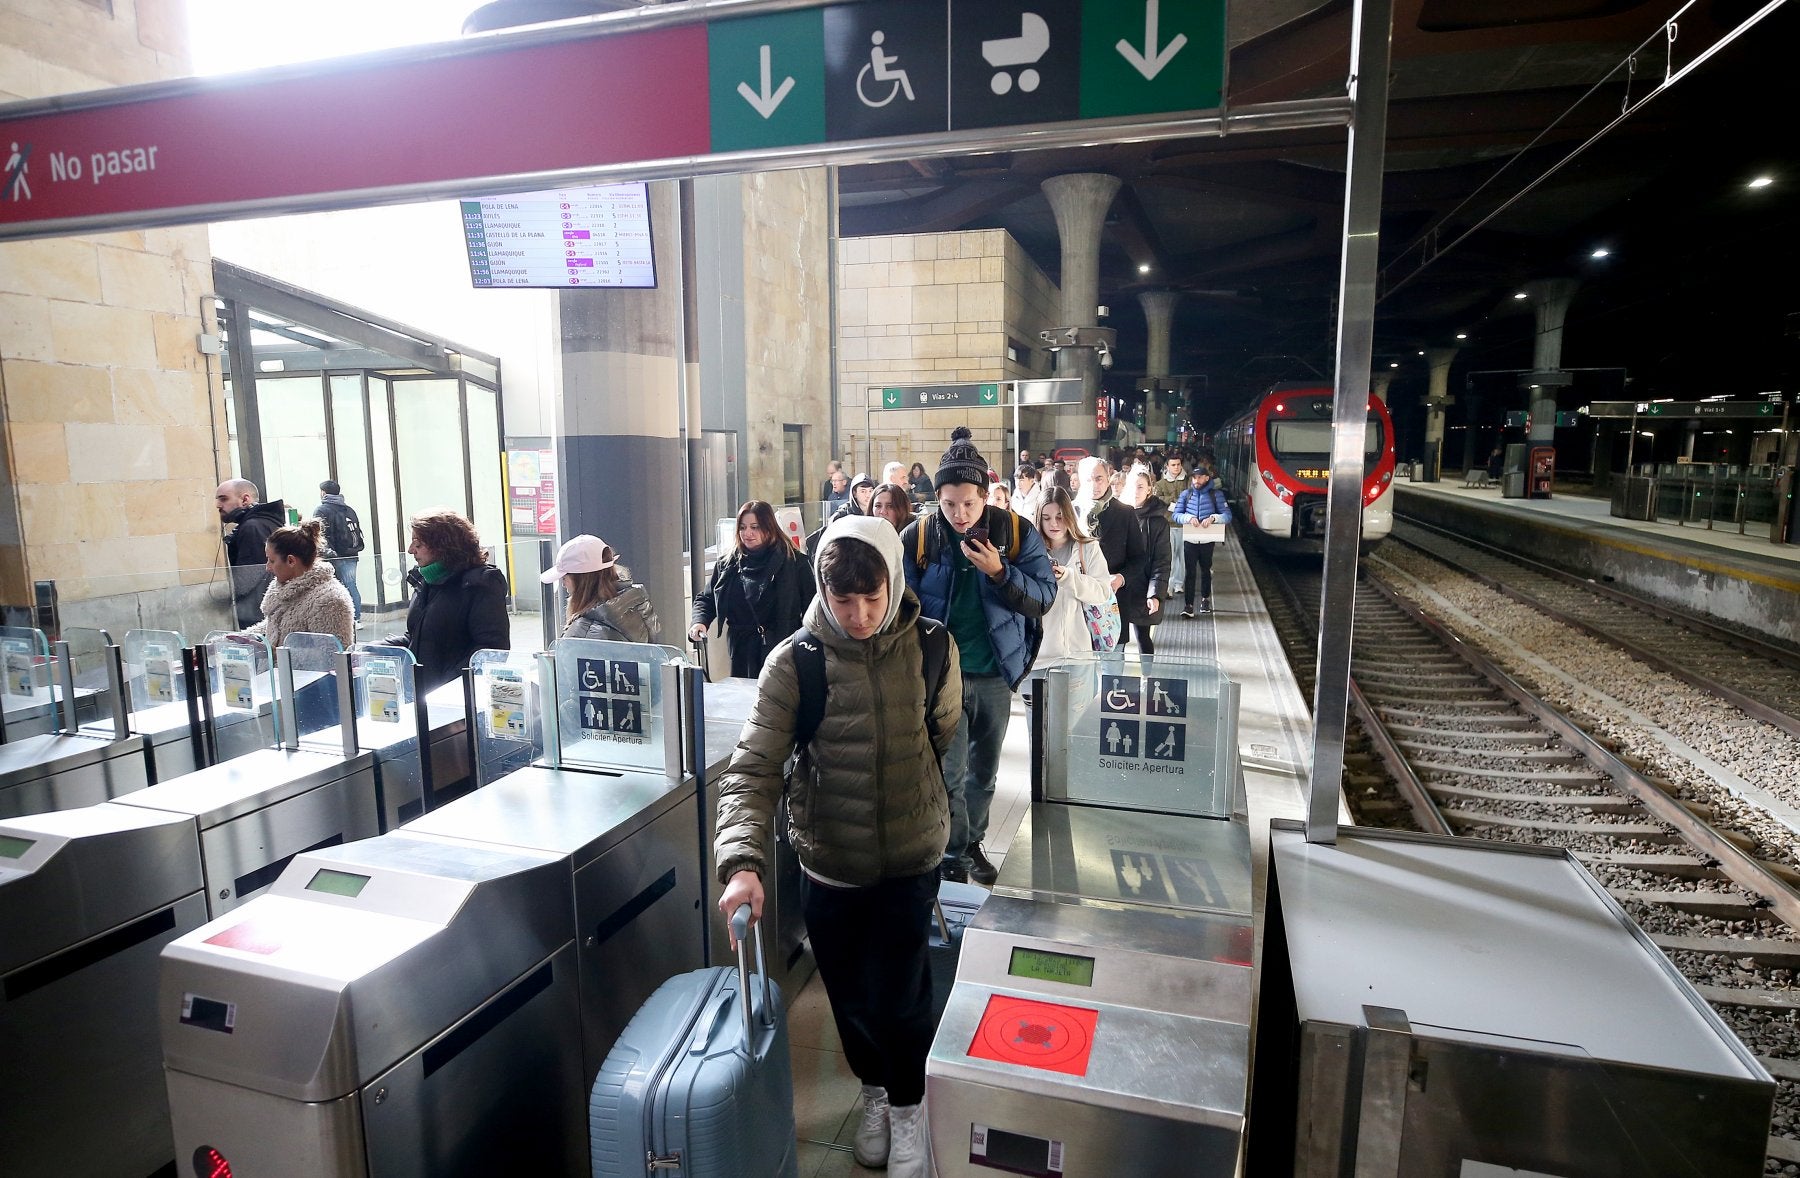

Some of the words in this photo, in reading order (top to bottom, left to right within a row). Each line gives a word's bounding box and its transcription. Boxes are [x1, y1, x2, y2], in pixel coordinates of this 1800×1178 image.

[50, 151, 82, 183] No
[91, 145, 158, 185] pasar
[1507, 418, 1513, 426] 1
[1571, 418, 1577, 426] 5
[581, 731, 611, 742] Soliciten
[612, 734, 643, 745] Apertura
[1142, 762, 1184, 775] Apertura
